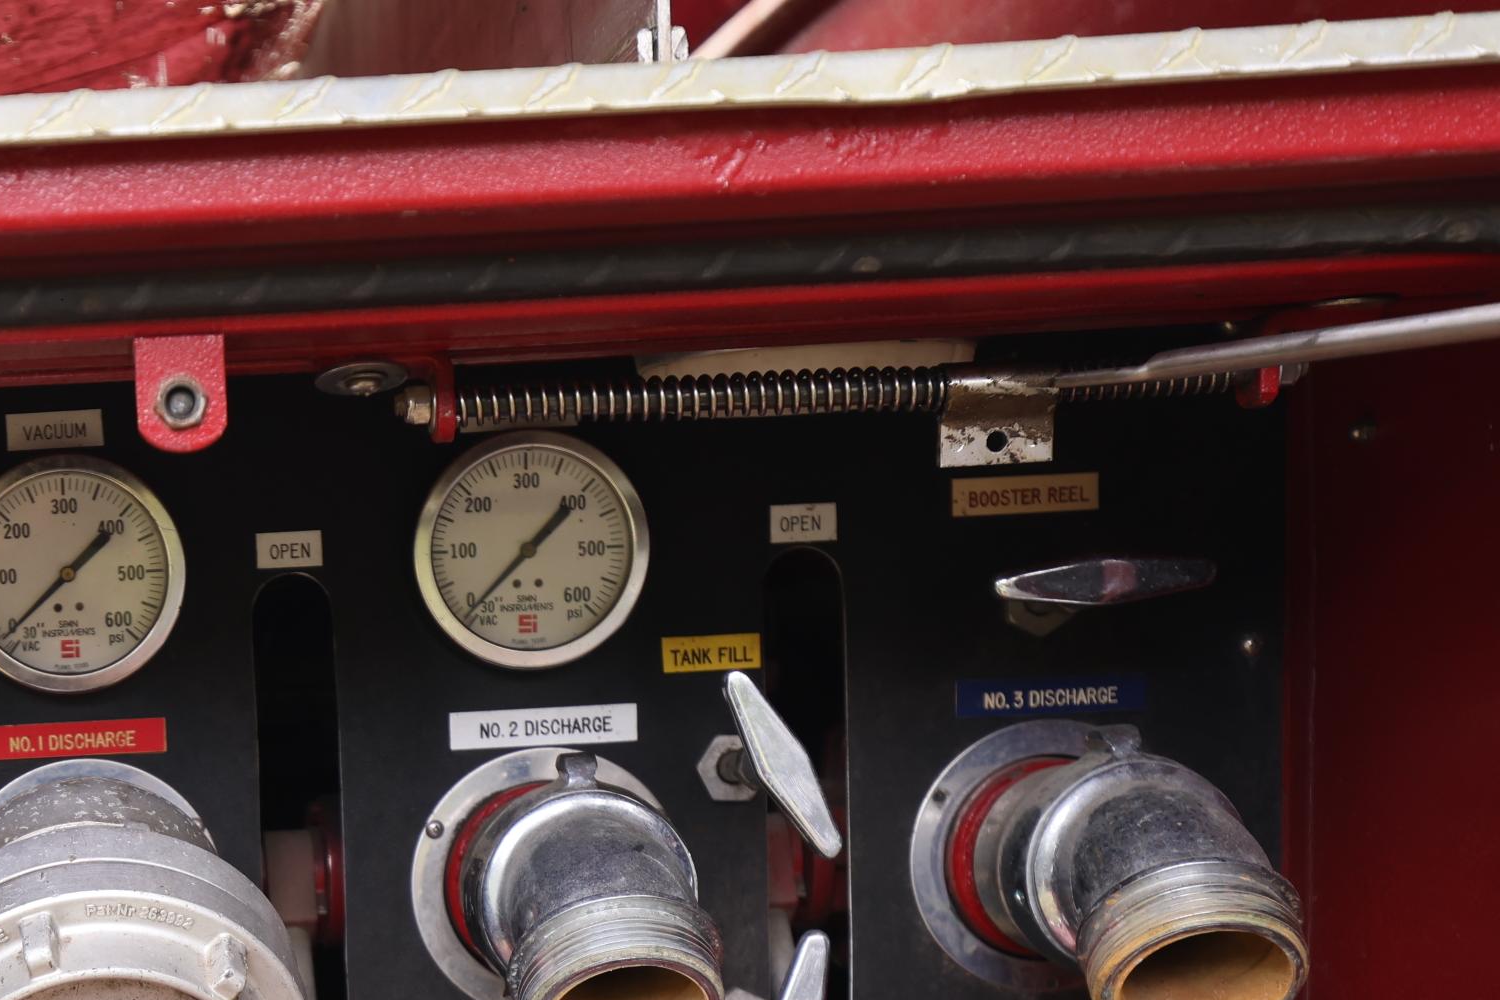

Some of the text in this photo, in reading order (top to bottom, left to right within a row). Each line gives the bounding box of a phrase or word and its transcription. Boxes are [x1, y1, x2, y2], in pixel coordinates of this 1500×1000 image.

[22, 422, 87, 441] VACUUM
[513, 473, 540, 489] 300
[560, 495, 586, 510] 400
[968, 485, 1091, 508] BOOSTER REEL
[51, 498, 77, 514] 300
[465, 497, 492, 513] 200
[3, 523, 30, 539] 200
[98, 519, 125, 535] 400
[780, 515, 821, 532] OPEN
[269, 542, 311, 560] OPEN
[450, 543, 477, 558] 100
[578, 541, 605, 556] 500
[117, 565, 145, 581] 500
[466, 592, 475, 608] 0
[564, 587, 591, 602] 600
[104, 611, 132, 627] 600
[480, 615, 498, 626] VAC
[567, 607, 583, 621] psi
[8, 618, 17, 633] 0
[22, 640, 40, 652] VAC
[109, 631, 125, 645] psi
[670, 645, 753, 667] TANK FILL
[983, 685, 1118, 710] NO. 3 DISCHARGE
[480, 715, 613, 739] NO. 2 DISCHARGE
[9, 736, 36, 753] NO.
[48, 730, 136, 751] DISCHARGE
